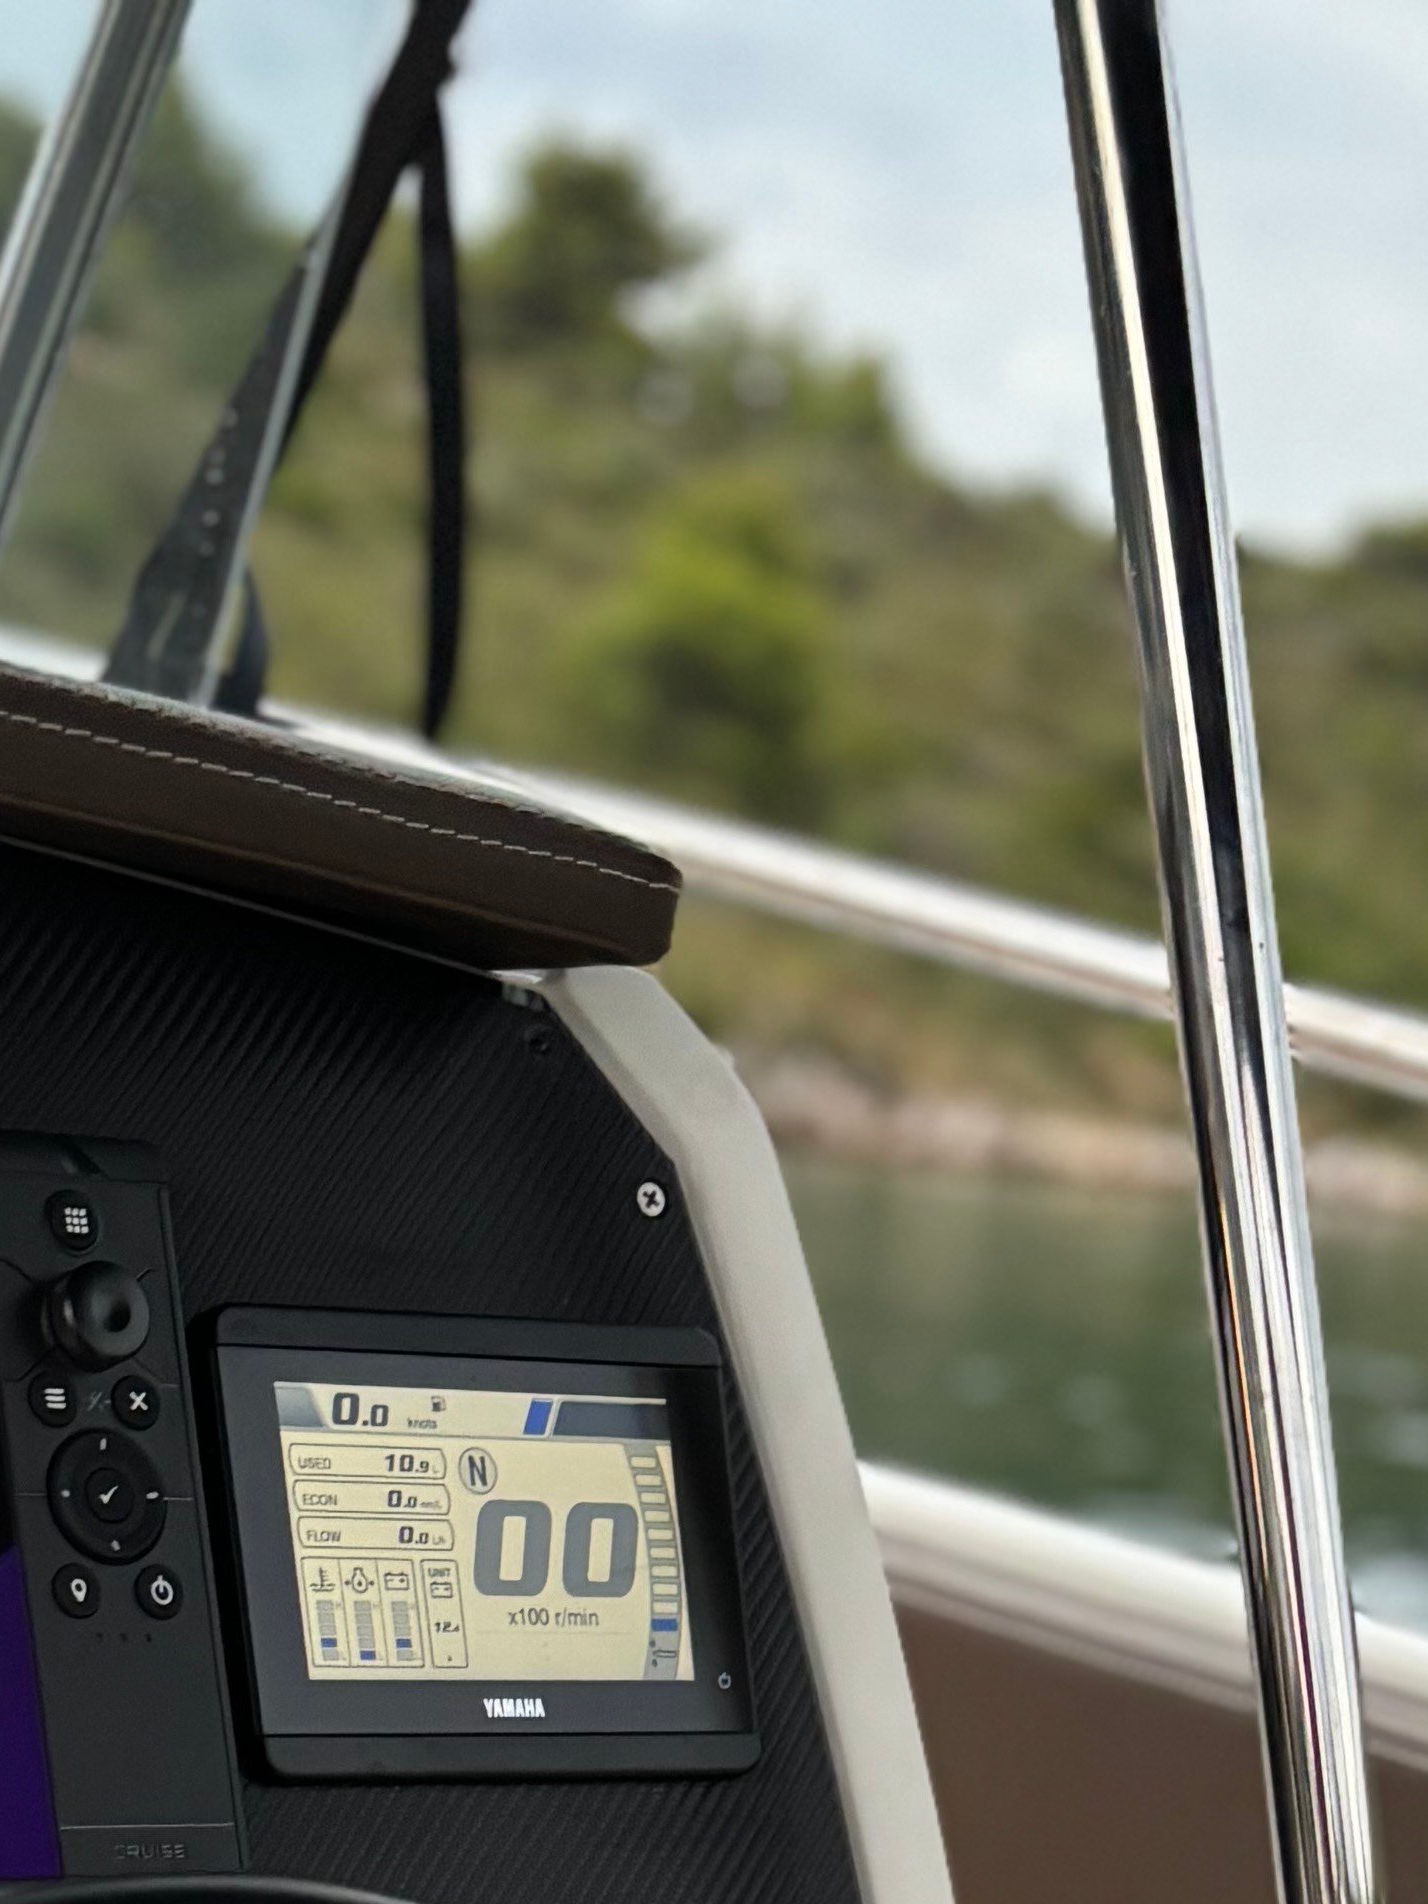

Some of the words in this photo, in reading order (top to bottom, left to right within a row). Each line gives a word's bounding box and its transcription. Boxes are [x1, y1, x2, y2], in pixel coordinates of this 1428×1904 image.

[332, 1392, 389, 1426] 0.0
[298, 1456, 332, 1470] USED
[385, 1453, 429, 1472] 10.9
[468, 1454, 488, 1488] N
[302, 1493, 338, 1506] ECON
[387, 1490, 418, 1509] 0.0
[306, 1529, 341, 1542] FLOW
[399, 1526, 429, 1544] 0.0
[473, 1499, 638, 1597] 00
[508, 1608, 549, 1626] x100
[555, 1608, 599, 1626] r/min
[483, 1698, 545, 1717] YAMAHA
[113, 1843, 185, 1860] CRUISE
